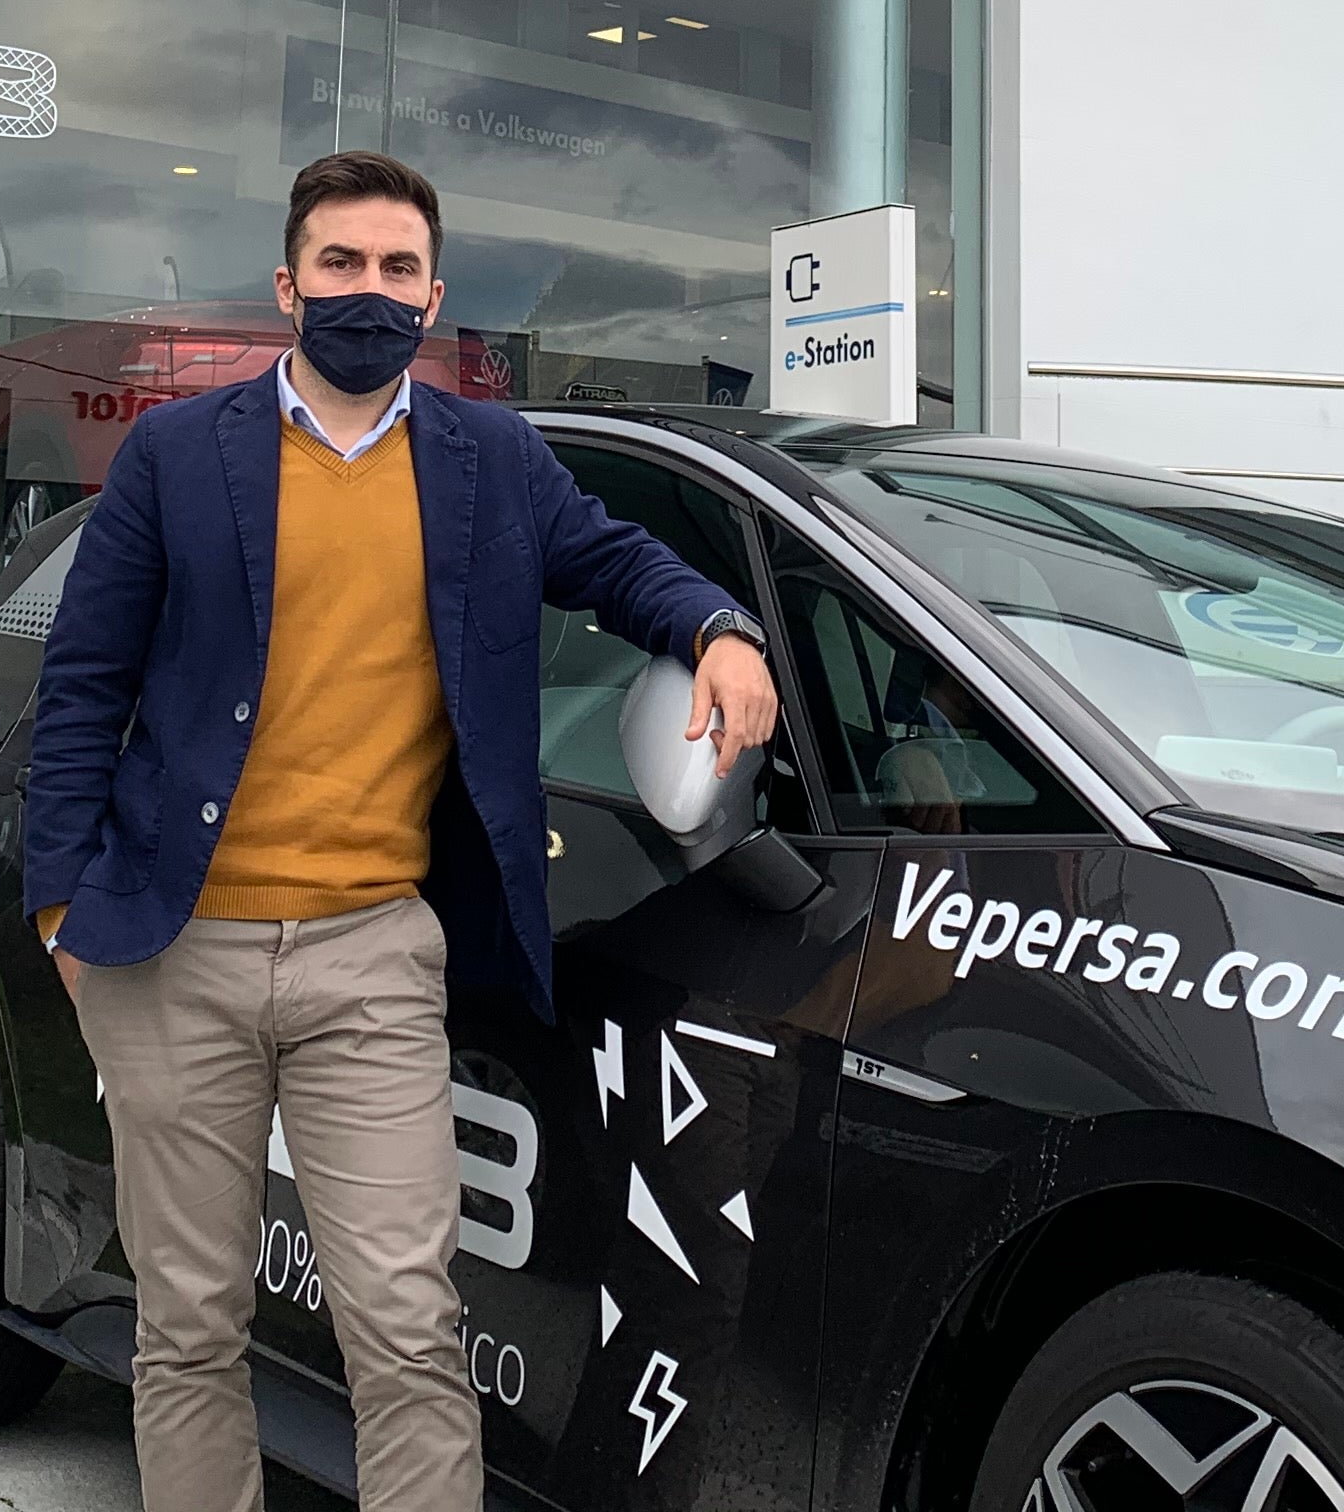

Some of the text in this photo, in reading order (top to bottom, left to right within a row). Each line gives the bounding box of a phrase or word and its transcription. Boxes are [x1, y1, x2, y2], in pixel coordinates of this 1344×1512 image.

[456, 112, 471, 131] a
[477, 109, 606, 157] Volkswagen
[785, 333, 875, 371] e-Station
[856, 1057, 885, 1078] 1ST
